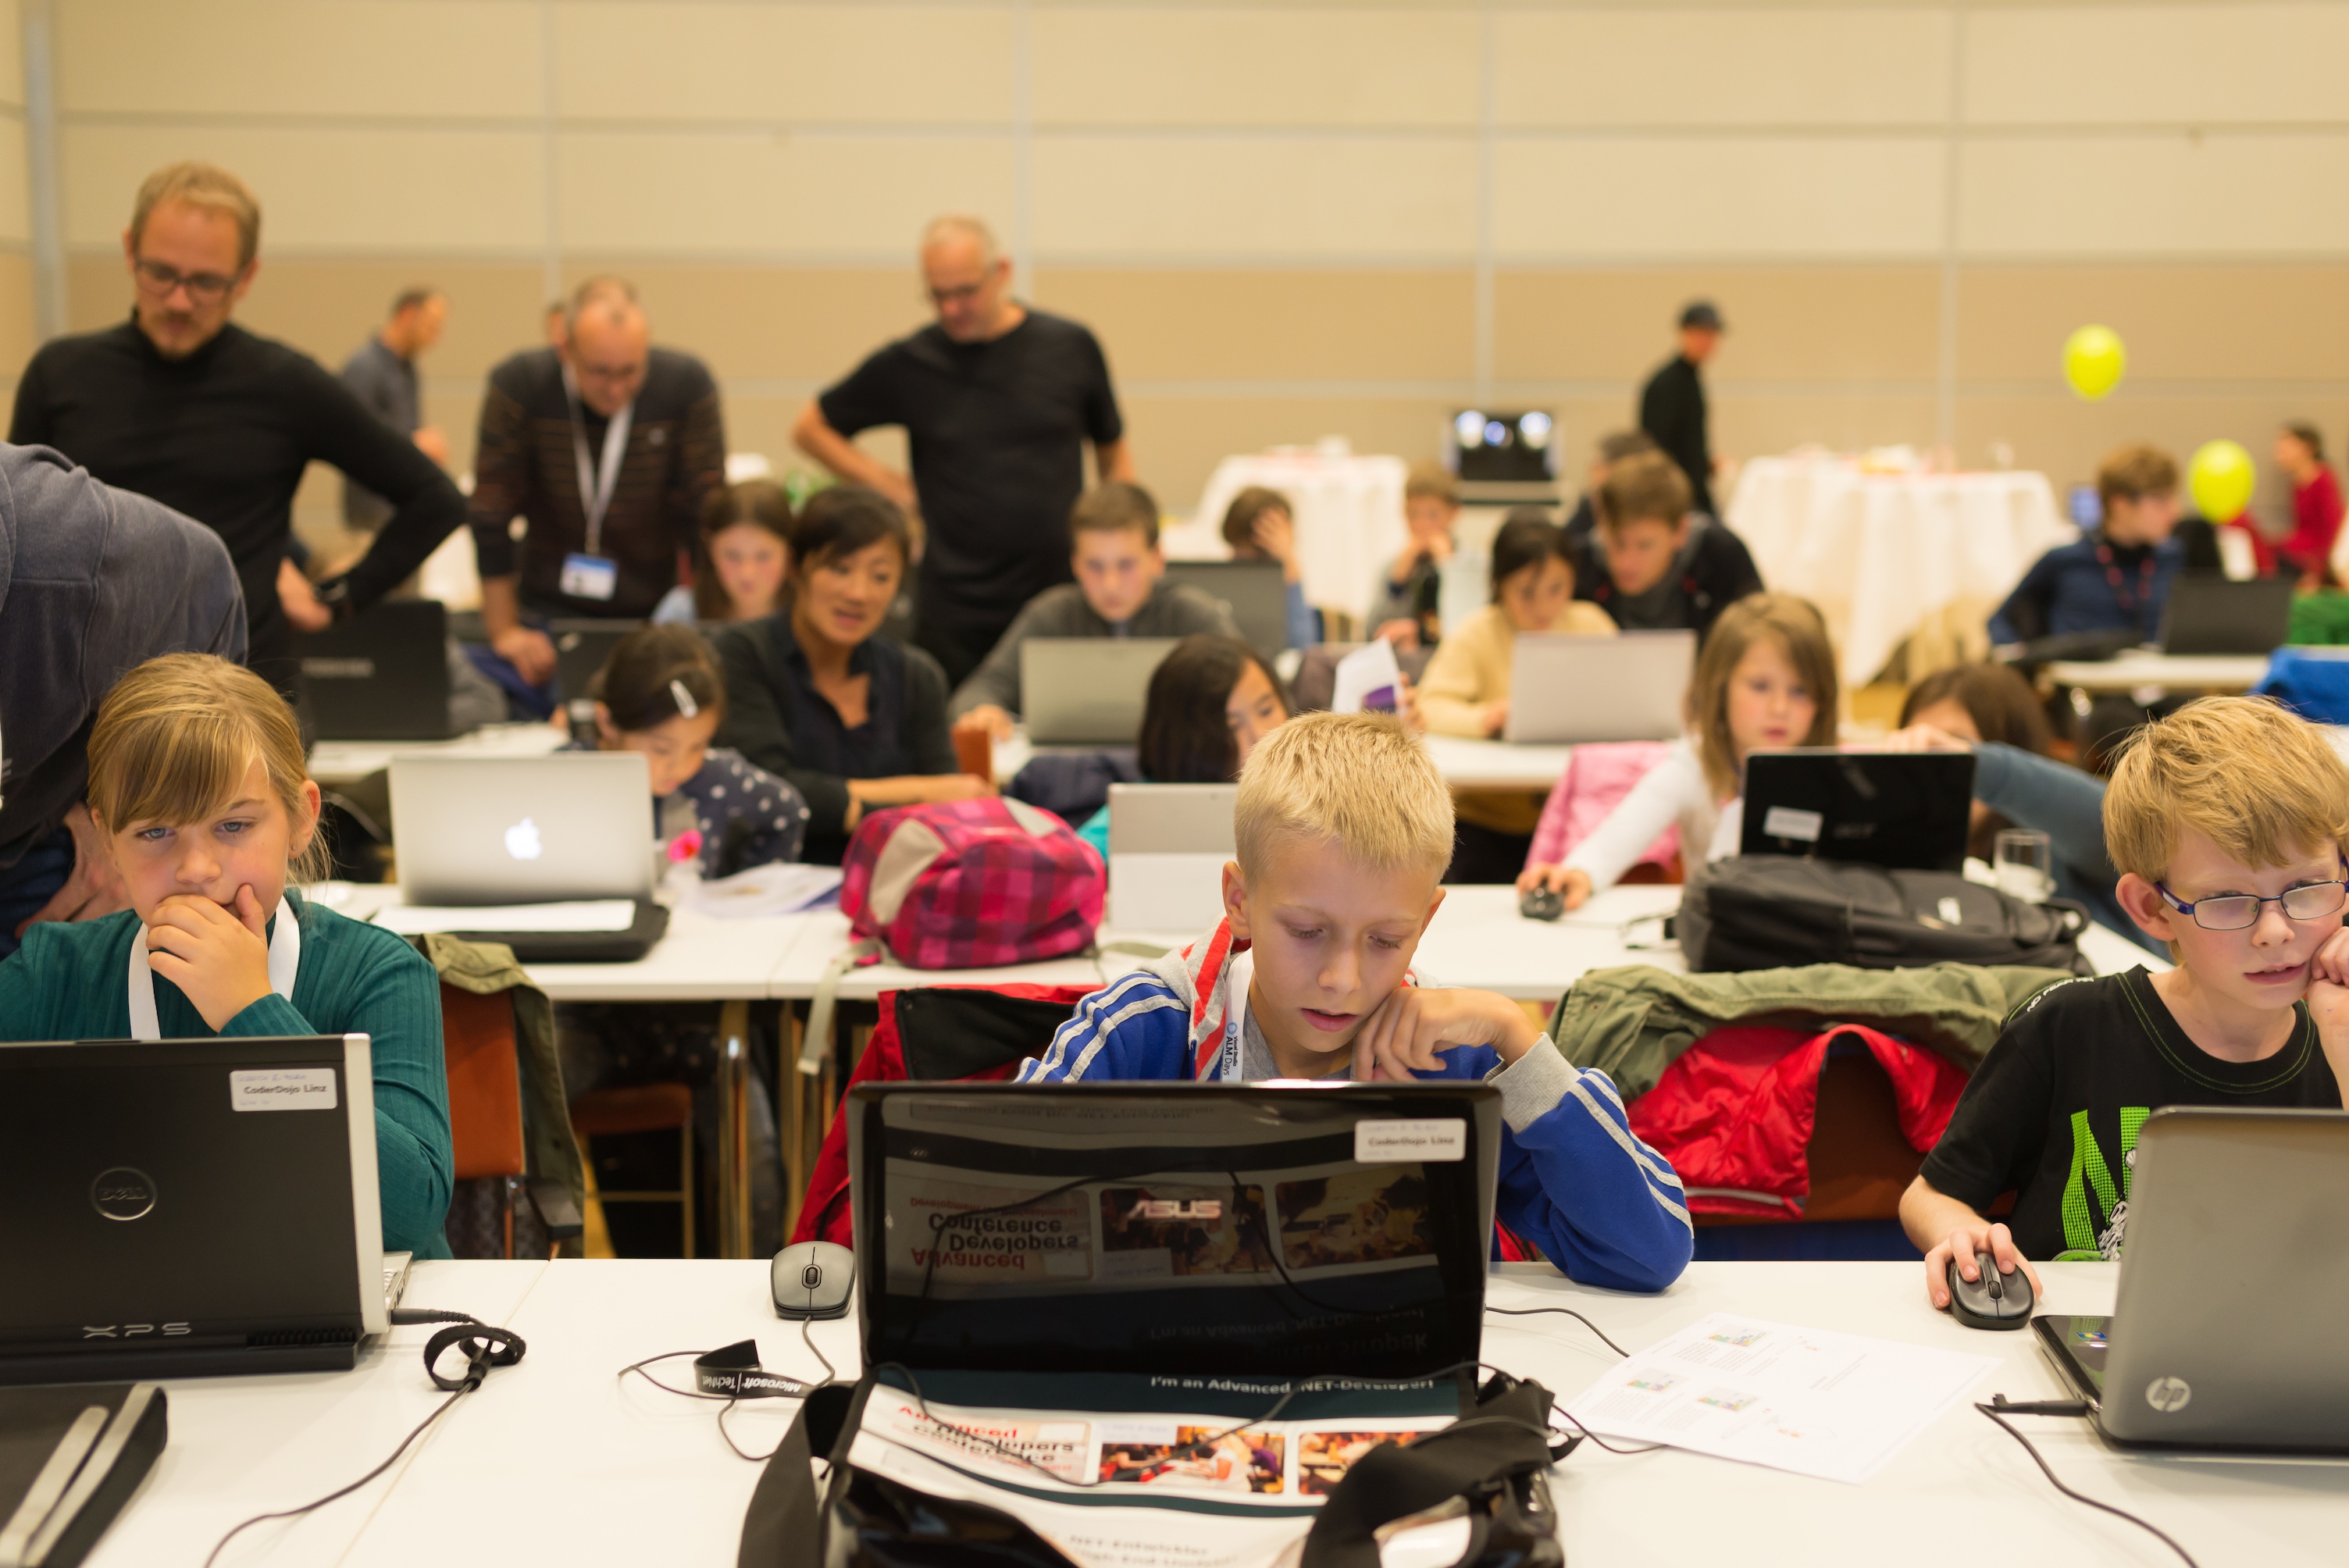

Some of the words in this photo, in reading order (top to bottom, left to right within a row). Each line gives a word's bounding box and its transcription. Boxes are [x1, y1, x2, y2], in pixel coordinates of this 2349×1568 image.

[2026, 995, 2042, 1013] NO
[1223, 1057, 1232, 1076] Days
[244, 1085, 301, 1095] CoderDojo
[304, 1084, 327, 1092] Linz
[1368, 1135, 1427, 1147] CoderDojo
[1430, 1134, 1455, 1146] Linz
[98, 1187, 148, 1201] DELL
[1128, 1199, 1222, 1219] ASUS
[83, 1322, 191, 1338] XPS
[702, 1375, 736, 1389] TechNet
[743, 1377, 802, 1392] Microsoft
[1151, 1376, 1178, 1388] I'm
[1182, 1378, 1203, 1388] an
[1207, 1378, 1290, 1394] Advanced
